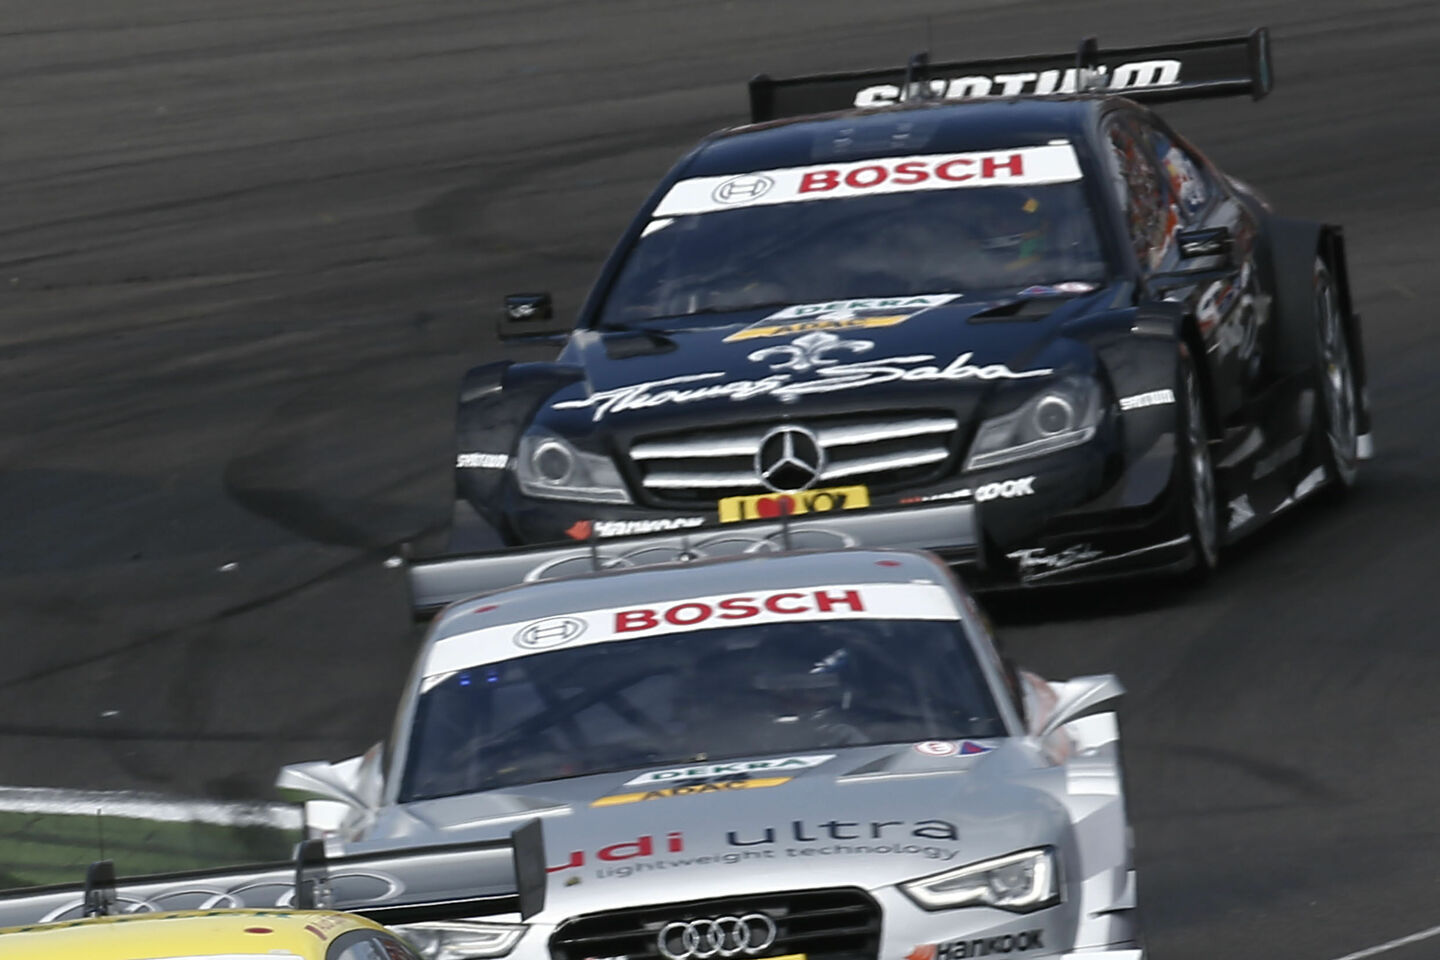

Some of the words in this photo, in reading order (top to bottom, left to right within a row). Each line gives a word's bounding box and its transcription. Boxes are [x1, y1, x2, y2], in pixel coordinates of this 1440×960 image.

[797, 153, 1025, 194] BOSCH
[613, 589, 865, 634] BOSCH
[652, 758, 808, 781] DEKRA
[545, 831, 685, 873] udi
[726, 817, 960, 847] ultra
[596, 847, 775, 879] lightweight
[786, 841, 961, 861] technology
